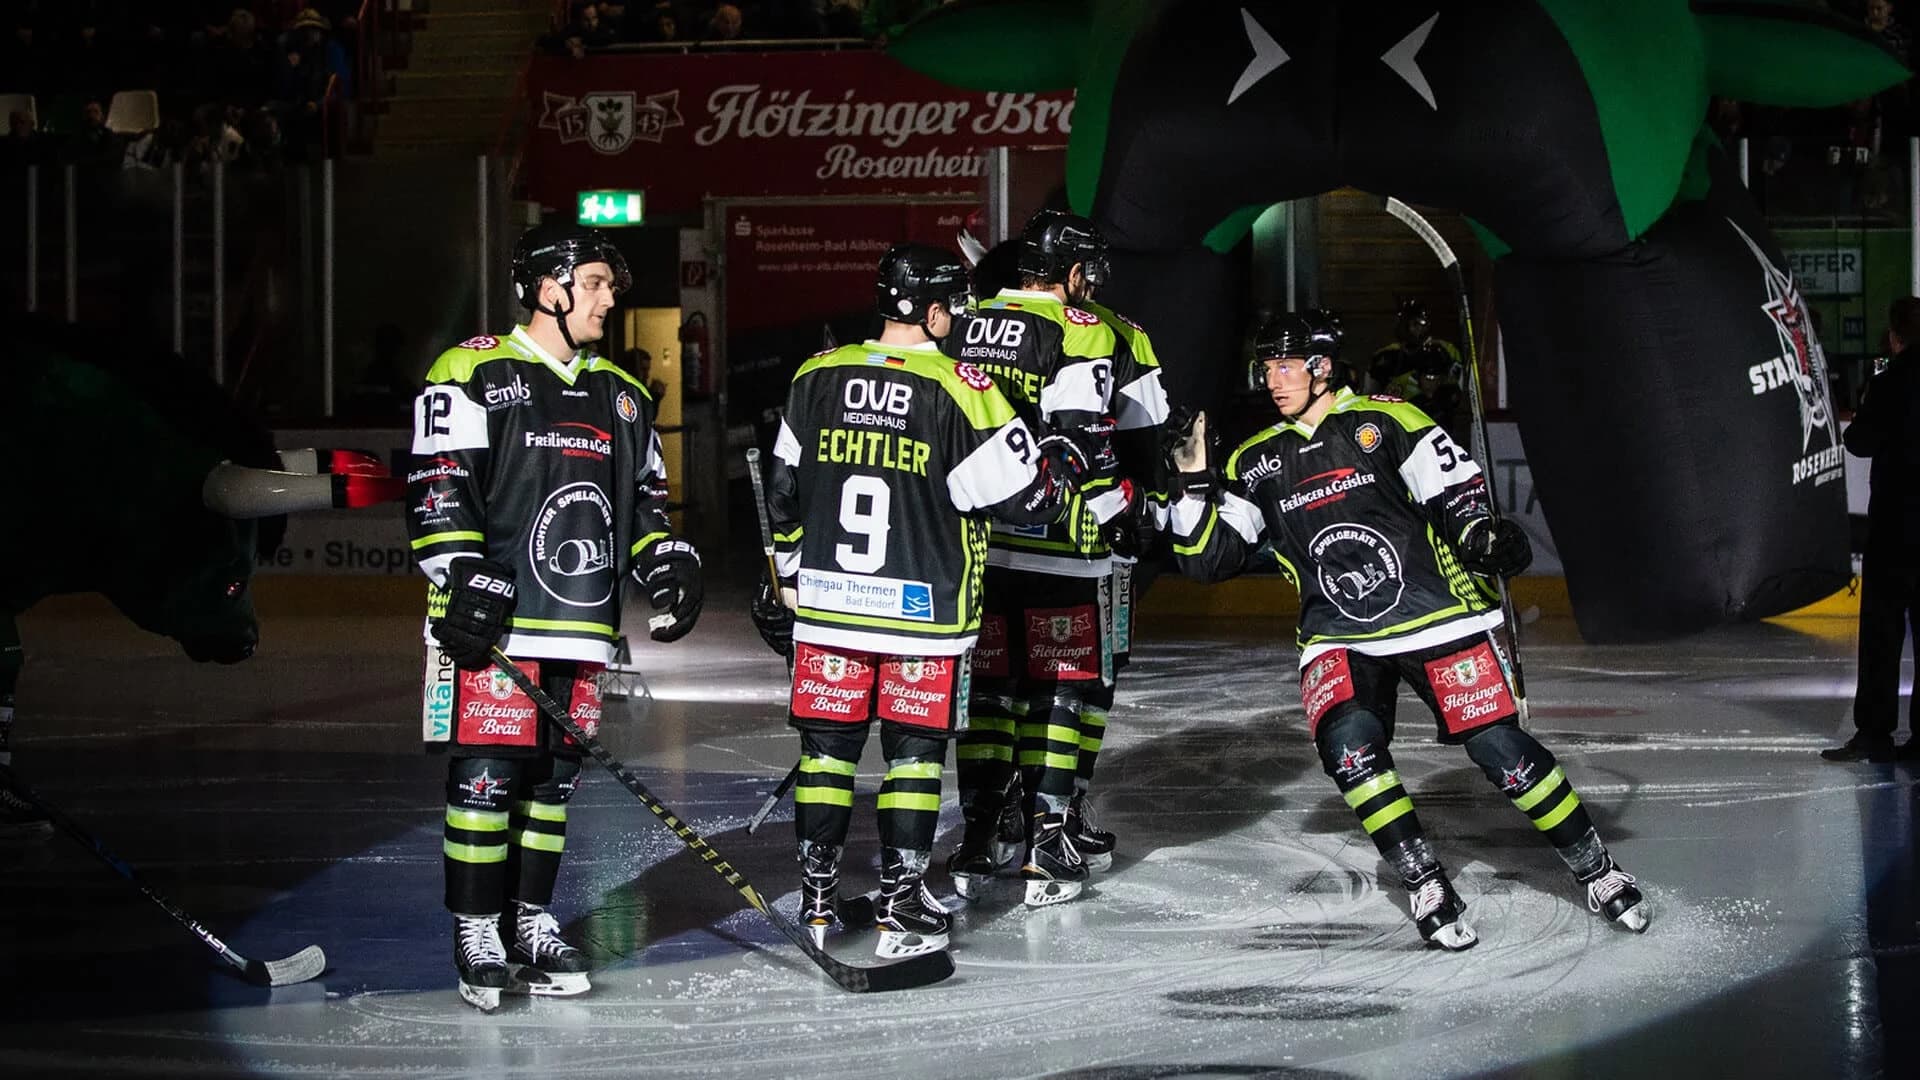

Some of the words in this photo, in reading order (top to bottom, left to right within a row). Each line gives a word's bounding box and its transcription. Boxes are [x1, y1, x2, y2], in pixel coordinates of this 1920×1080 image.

[694, 83, 971, 148] Flötzinger
[966, 317, 1027, 347] OVB
[844, 378, 914, 416] OVB
[423, 392, 452, 438] 12
[843, 411, 908, 431] MEDIENHAUS
[817, 428, 932, 478] ECHTLER
[1006, 427, 1032, 464] 9
[536, 508, 558, 561] RICHTER
[836, 475, 891, 574] 9
[845, 596, 862, 606] Bad
[847, 580, 897, 597] Thermen
[797, 679, 868, 700] Flötzinger
[880, 679, 946, 704] Flötzinger
[1443, 683, 1503, 712] Flötzinger
[463, 701, 534, 719] Flötzinger
[810, 697, 851, 714] Bräu
[890, 699, 929, 717] Bräu
[1461, 701, 1498, 721] Bräu
[478, 718, 522, 735] Bräu
